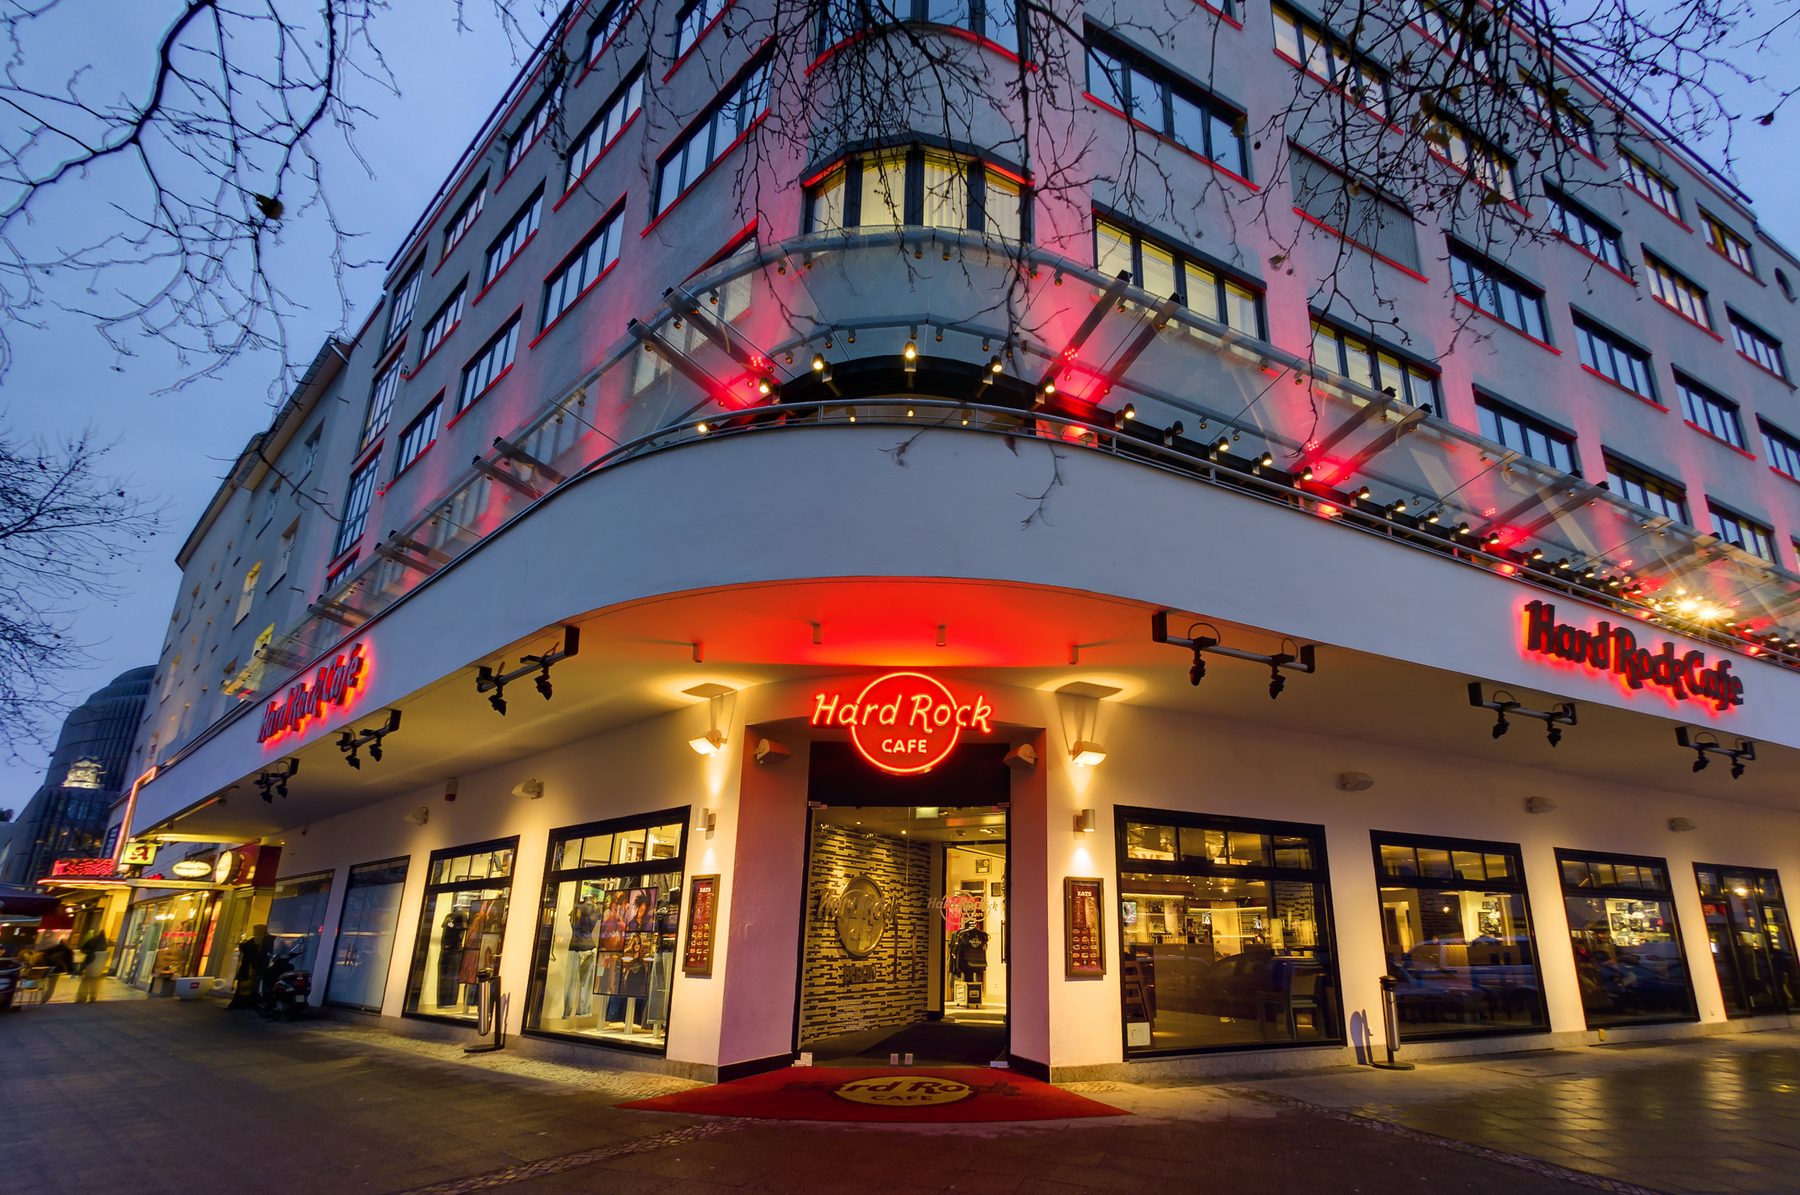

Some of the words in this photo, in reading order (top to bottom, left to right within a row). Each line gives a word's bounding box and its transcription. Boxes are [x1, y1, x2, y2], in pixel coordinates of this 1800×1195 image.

[1524, 600, 1610, 670] Hard
[1609, 627, 1687, 700] Rock
[1684, 650, 1744, 711] Cafe
[257, 687, 295, 743] Hard
[289, 666, 328, 731] Rock
[322, 642, 364, 706] Cafe
[810, 693, 903, 727] Hard
[909, 694, 992, 733] Rock
[881, 738, 928, 754] CAFE
[778, 1081, 903, 1093] Hard
[906, 1081, 1021, 1096] Rock
